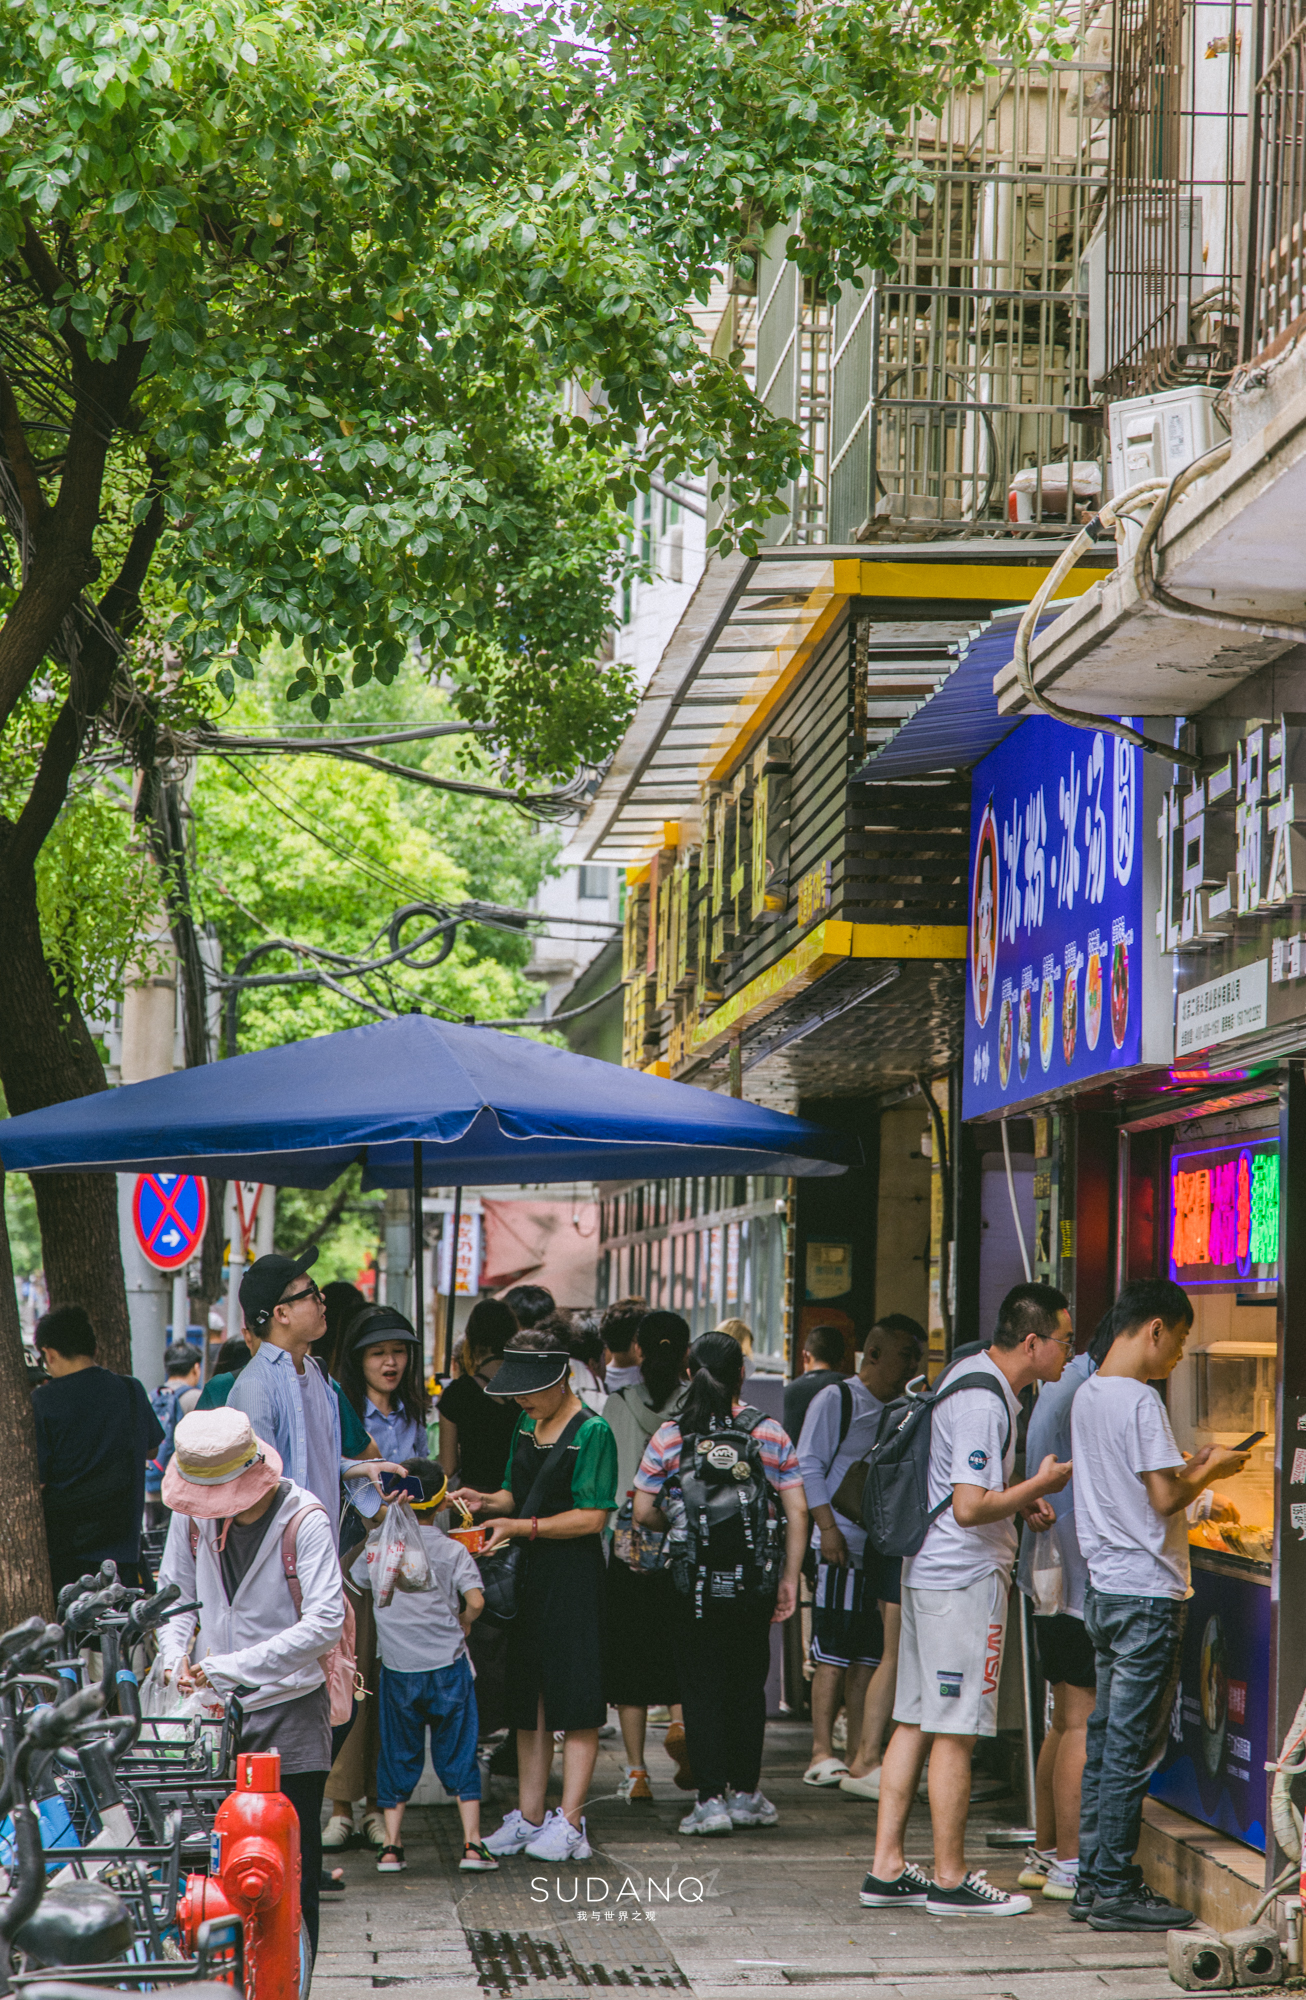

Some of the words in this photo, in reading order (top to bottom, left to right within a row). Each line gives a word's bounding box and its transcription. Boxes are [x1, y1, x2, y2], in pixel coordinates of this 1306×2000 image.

[1156, 714, 1295, 954] 北京二锅头
[969, 1455, 986, 1466] NASA
[982, 1624, 1003, 1695] NASA
